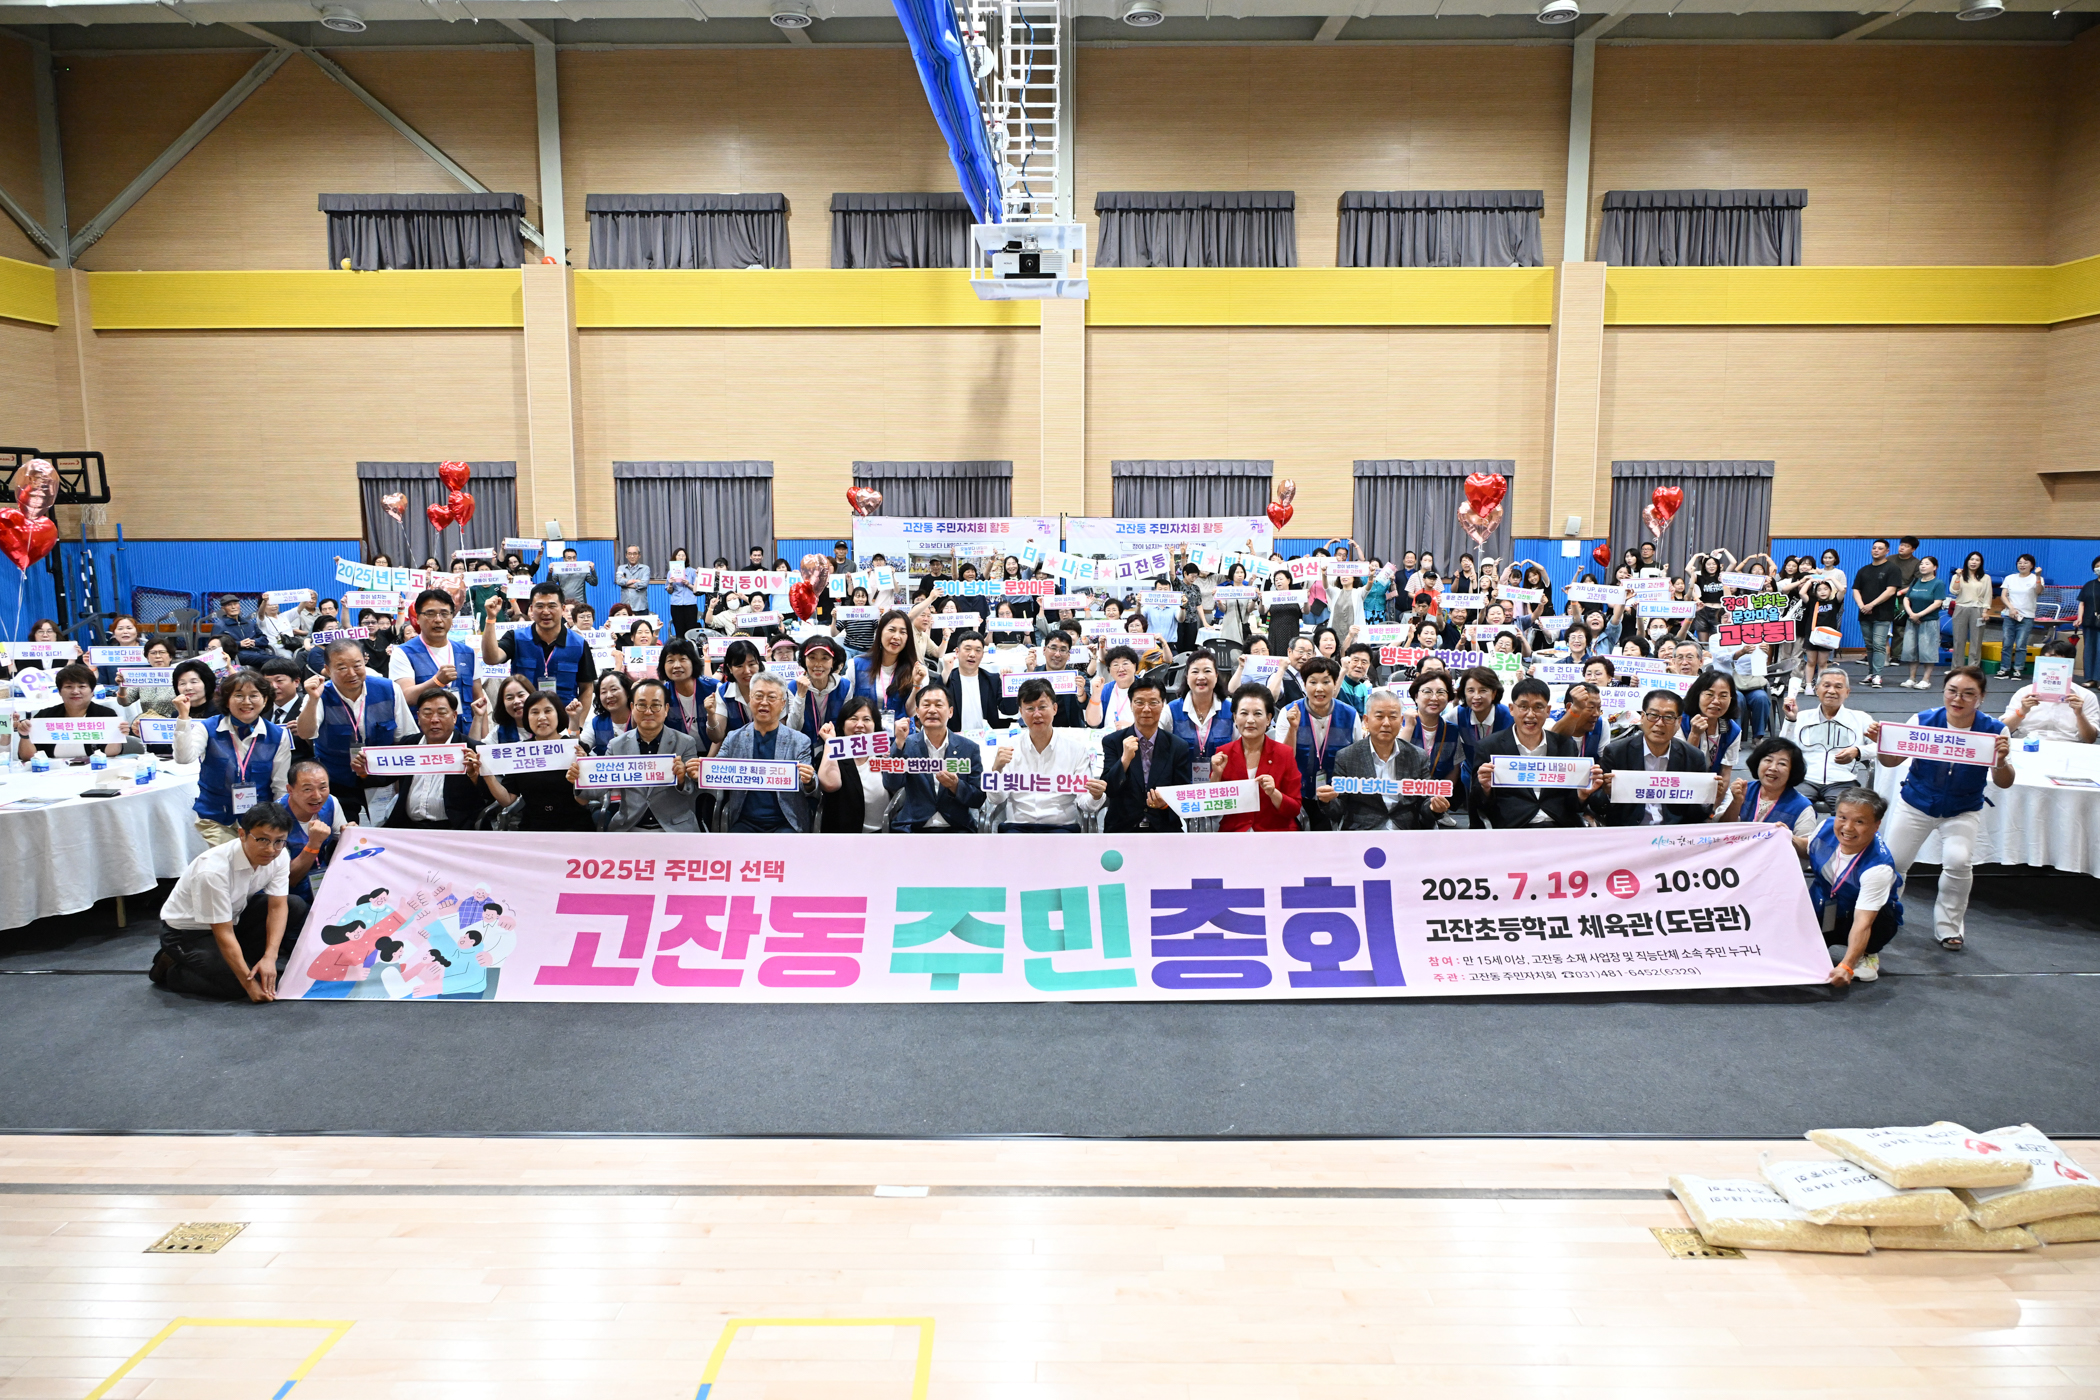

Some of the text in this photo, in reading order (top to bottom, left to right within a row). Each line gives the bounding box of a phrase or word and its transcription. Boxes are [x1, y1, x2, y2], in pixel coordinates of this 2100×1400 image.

[903, 522, 1010, 533] 고잔동 주민자치회 활동
[1116, 522, 1223, 534] 고잔동 주민자치회 활동
[1023, 546, 1166, 578] 더 나은 고잔동
[1190, 549, 1203, 564] 더
[1291, 560, 1319, 579] 안산
[964, 581, 1001, 595] 넘치는
[1005, 580, 1055, 595] 문화마을
[1723, 594, 1788, 611] 정이 넘치는
[1733, 609, 1779, 624] 문화마을
[313, 627, 368, 644] 명품이 되다
[1719, 620, 1795, 646] 고잔동!
[1640, 678, 1676, 690] 더 빛나는
[1601, 698, 1626, 708] 고잔동
[45, 721, 105, 731] 행복한 변화의
[50, 731, 104, 741] 중심 고잔동!
[1909, 730, 1966, 746] 정이 넘치는
[491, 744, 564, 759] 좋은 건 다 같이
[828, 733, 890, 759] 고잔동
[1897, 741, 1976, 759] 문화마을 고잔동
[377, 753, 455, 766] 더 나은 고잔동
[513, 757, 547, 770] 고잔동
[596, 761, 657, 772] 안산선 지하화
[869, 759, 970, 773] 행복한 변화의 중심
[1509, 761, 1576, 772] 오늘보다 내일이
[588, 772, 665, 782] 안산 더 나은 내일
[711, 765, 786, 776] 안산에 한 획을 긋다
[1517, 772, 1566, 783] 좋은 고잔동
[706, 774, 792, 785] 안산선(고잔역) 지하화
[983, 773, 998, 791] 더
[1003, 774, 1050, 792] 빛나는
[1649, 776, 1680, 787] 고잔동
[1176, 786, 1239, 801] 행복한 변화의
[1333, 778, 1452, 796] 정이 넘치는 문화마을
[1635, 788, 1693, 799] 명품이 되다!
[1180, 799, 1237, 812] 중심 고잔동!
[565, 859, 785, 883] 2025년 주민의 선택
[1421, 867, 1740, 902] 2025. 7. 19. 토 10:00
[533, 847, 1407, 991] 고잔동 주민 총회
[1426, 905, 1752, 943] 고잔초등학교 체육관(도담관)
[1463, 956, 1474, 966] 만
[1477, 956, 1502, 966] 15세
[1532, 954, 1563, 965] 고잔동
[1566, 953, 1587, 964] 소재
[1590, 952, 1620, 963] 사업장
[1622, 951, 1633, 962] 및
[1636, 949, 1679, 962] 직능단체
[1681, 948, 1703, 959] 소속
[1705, 946, 1726, 958] 주민
[1728, 944, 1761, 957] 누구나
[1469, 972, 1501, 982] 고잔동
[1503, 970, 1557, 980] 주민자치회
